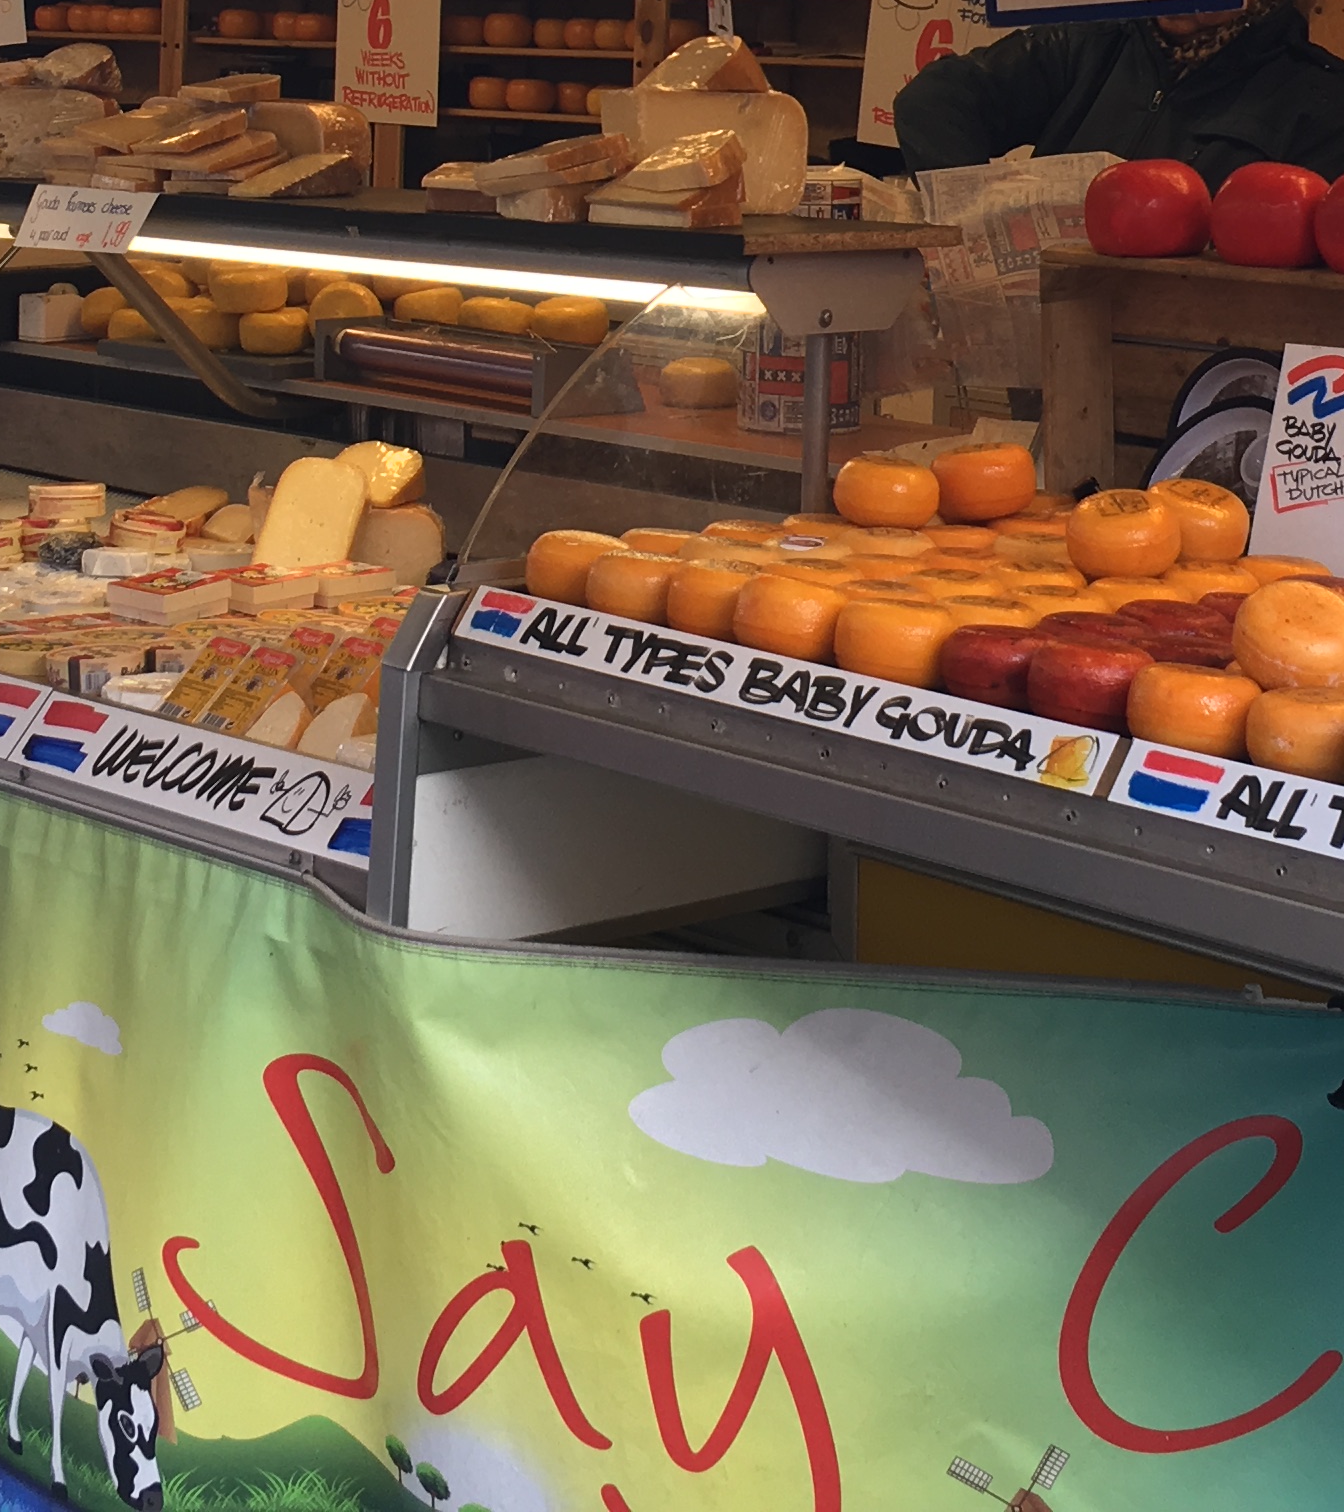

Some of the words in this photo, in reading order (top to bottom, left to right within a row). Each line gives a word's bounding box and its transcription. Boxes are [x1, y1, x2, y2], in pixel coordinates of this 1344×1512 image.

[361, 49, 405, 70] WEEKS
[355, 67, 409, 90] WITHOUT
[1282, 416, 1336, 449] BABY
[1275, 439, 1341, 464] GOUDA
[1286, 481, 1344, 502] DUTCH
[518, 605, 591, 658] ALL
[602, 622, 735, 694] TYPES
[737, 657, 881, 729] BABY
[875, 695, 1037, 772] GOUDA
[90, 724, 277, 813] WELCOME
[1215, 773, 1309, 842] ALL
[160, 1050, 844, 1512] Say
